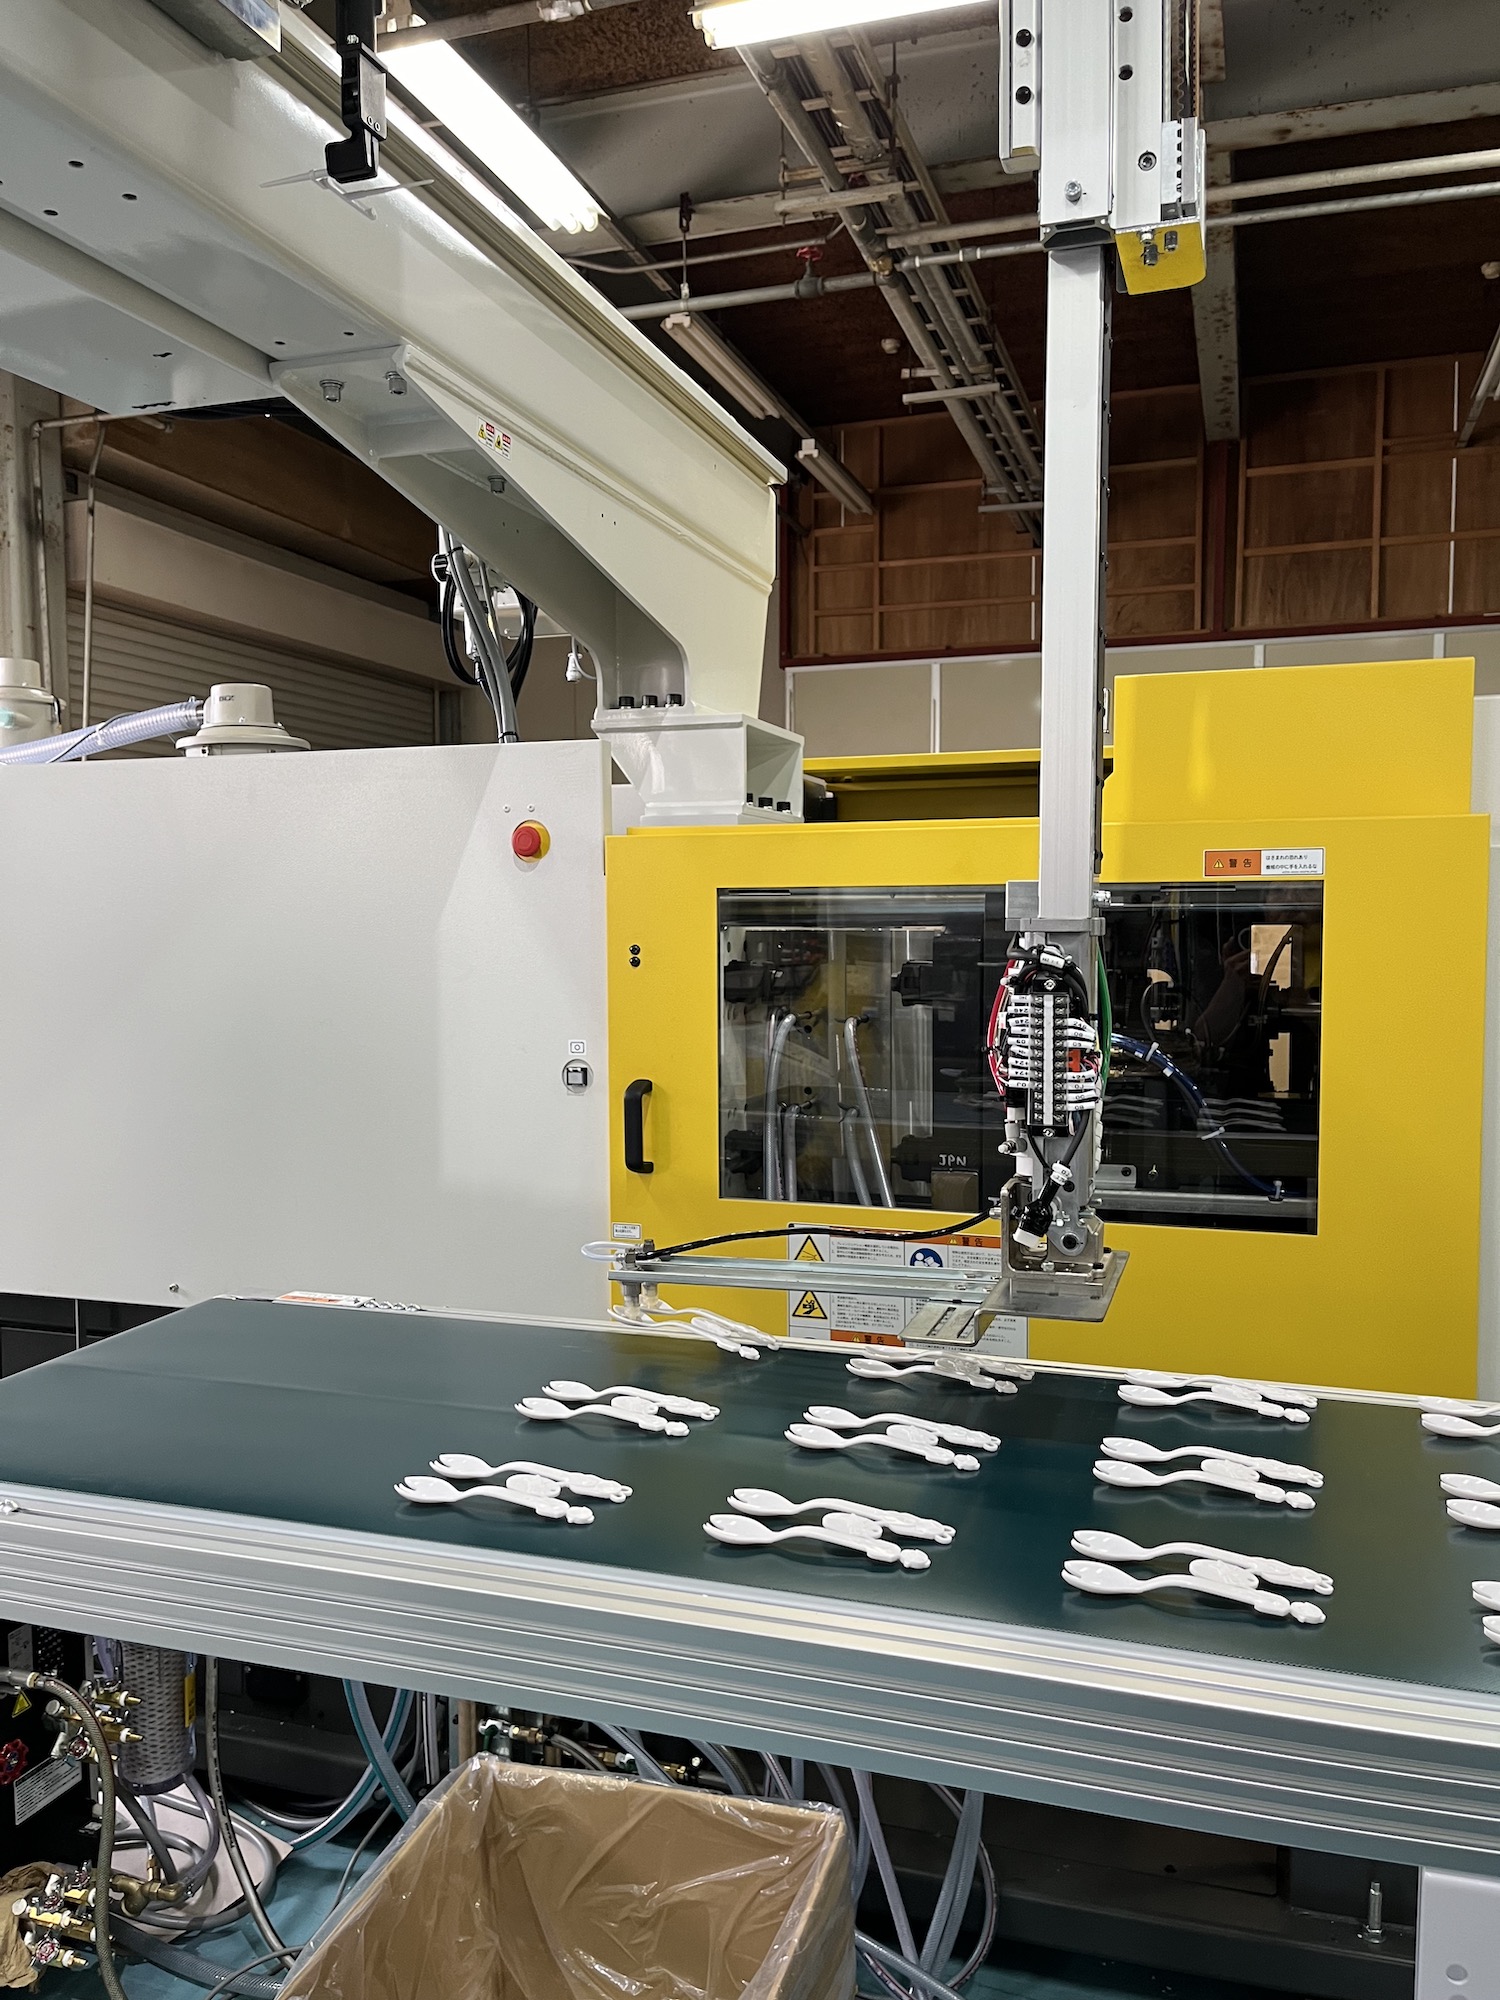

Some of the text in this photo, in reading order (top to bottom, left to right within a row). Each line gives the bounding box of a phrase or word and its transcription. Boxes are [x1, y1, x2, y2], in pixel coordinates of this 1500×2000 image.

[1229, 858, 1252, 868] 警告
[939, 1153, 967, 1167] JPN
[962, 1236, 983, 1248] 警告
